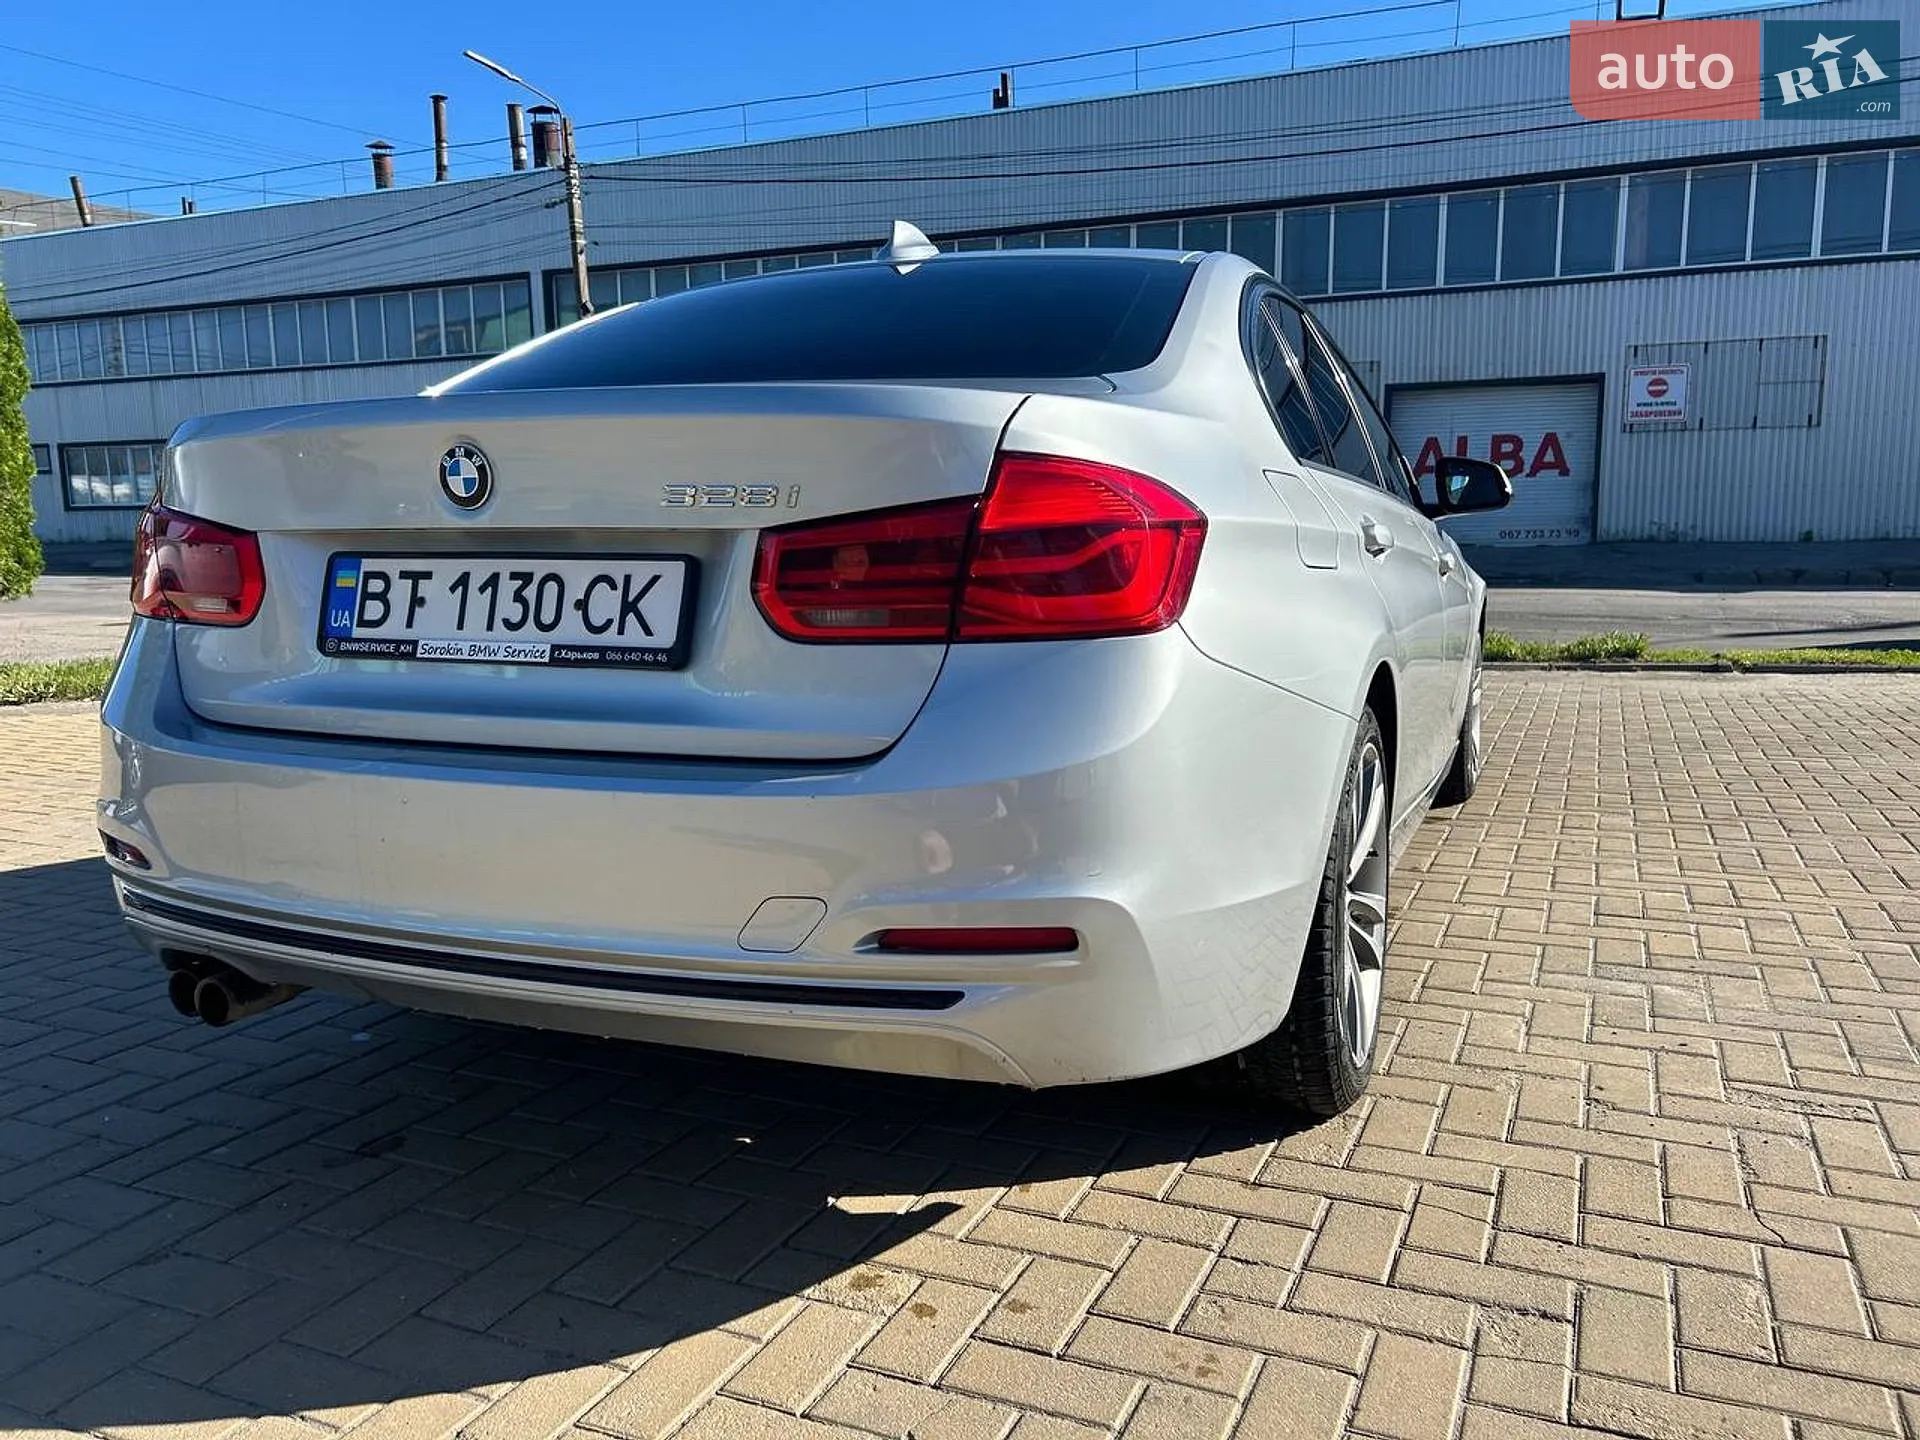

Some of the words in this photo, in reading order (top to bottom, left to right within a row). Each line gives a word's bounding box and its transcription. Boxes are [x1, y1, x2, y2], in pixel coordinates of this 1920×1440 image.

[661, 482, 801, 508] 328i
[356, 570, 433, 629] BT
[448, 571, 565, 633] 1130
[582, 574, 662, 637] CK
[331, 609, 351, 627] UA
[419, 643, 464, 656] Sorokin
[468, 643, 501, 657] BMW
[503, 645, 547, 659] Service
